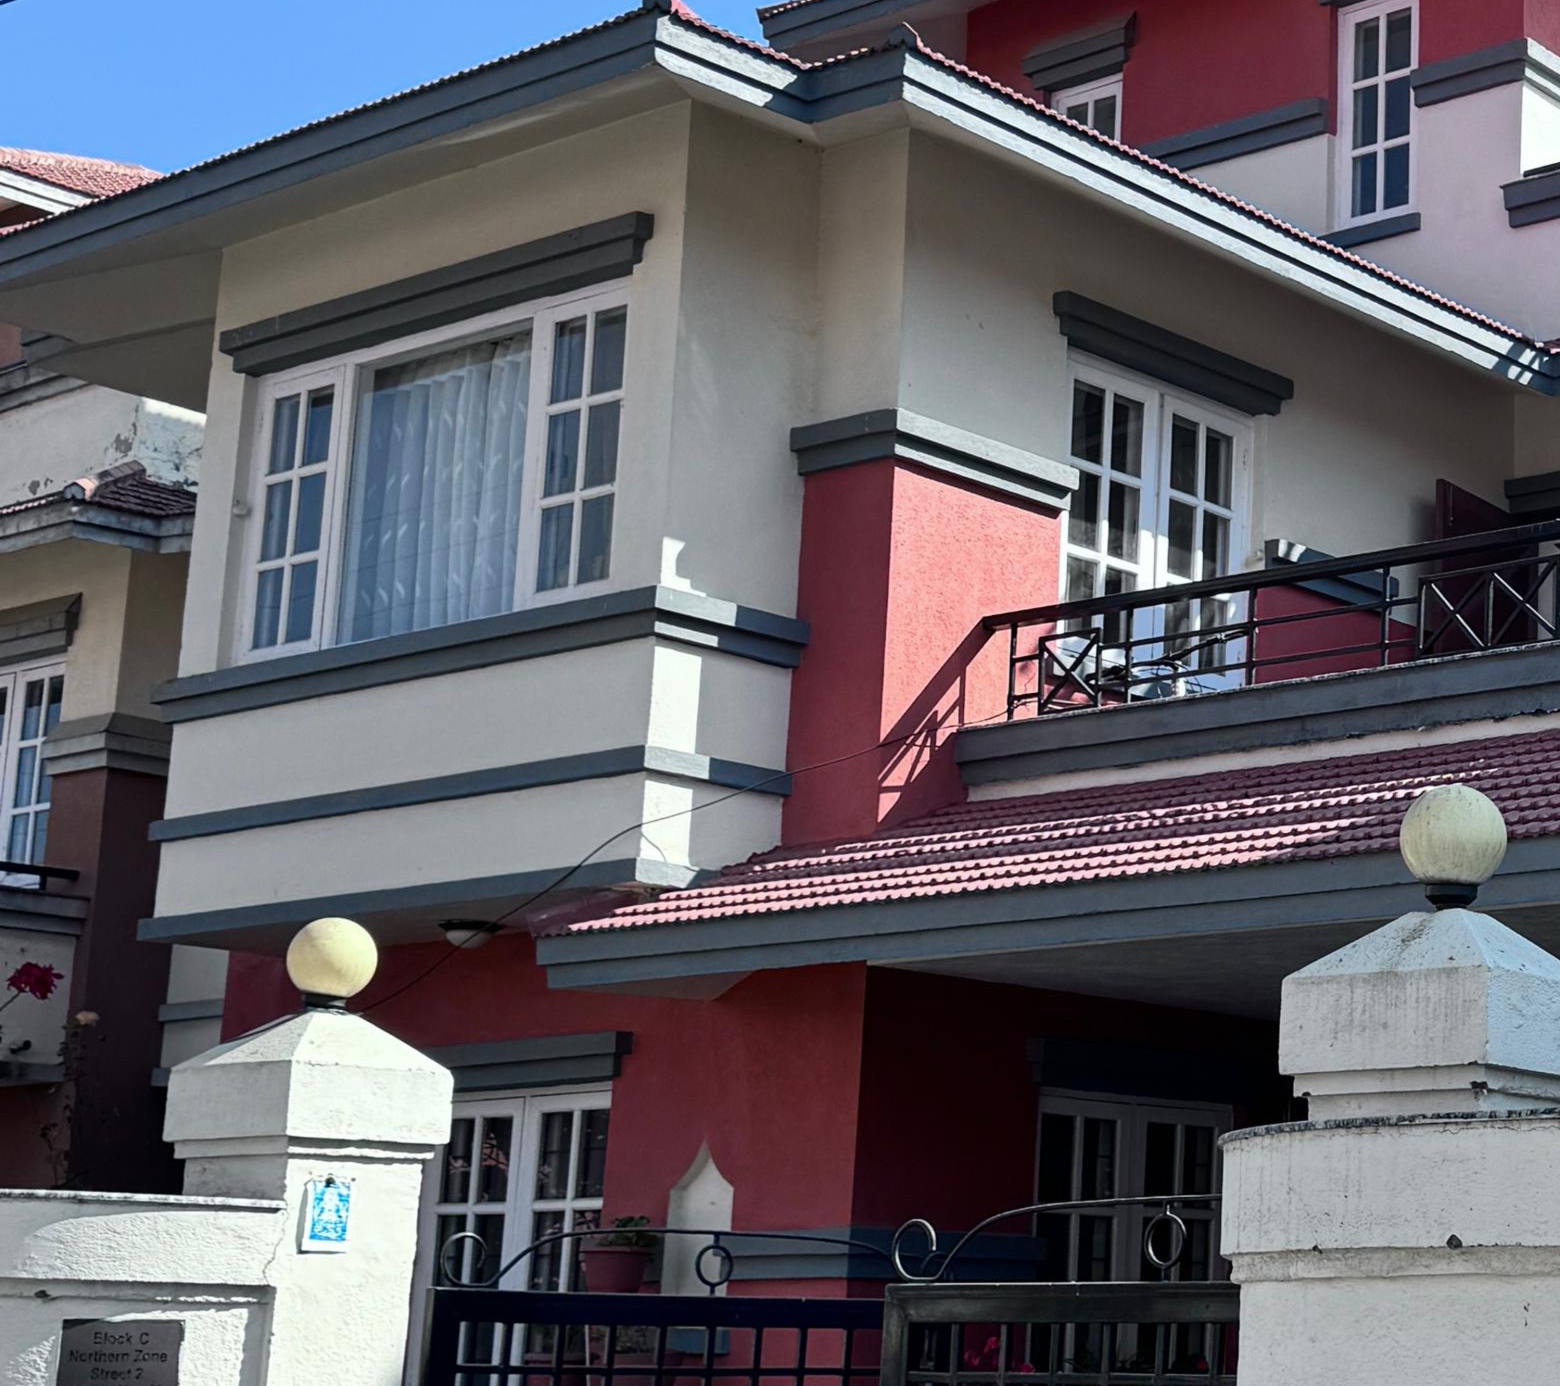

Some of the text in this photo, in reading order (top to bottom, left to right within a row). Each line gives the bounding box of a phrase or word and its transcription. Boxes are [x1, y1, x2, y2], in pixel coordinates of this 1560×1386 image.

[93, 1331, 150, 1345] Block C
[68, 1349, 168, 1363] Northern Zone
[90, 1367, 132, 1380] Street
